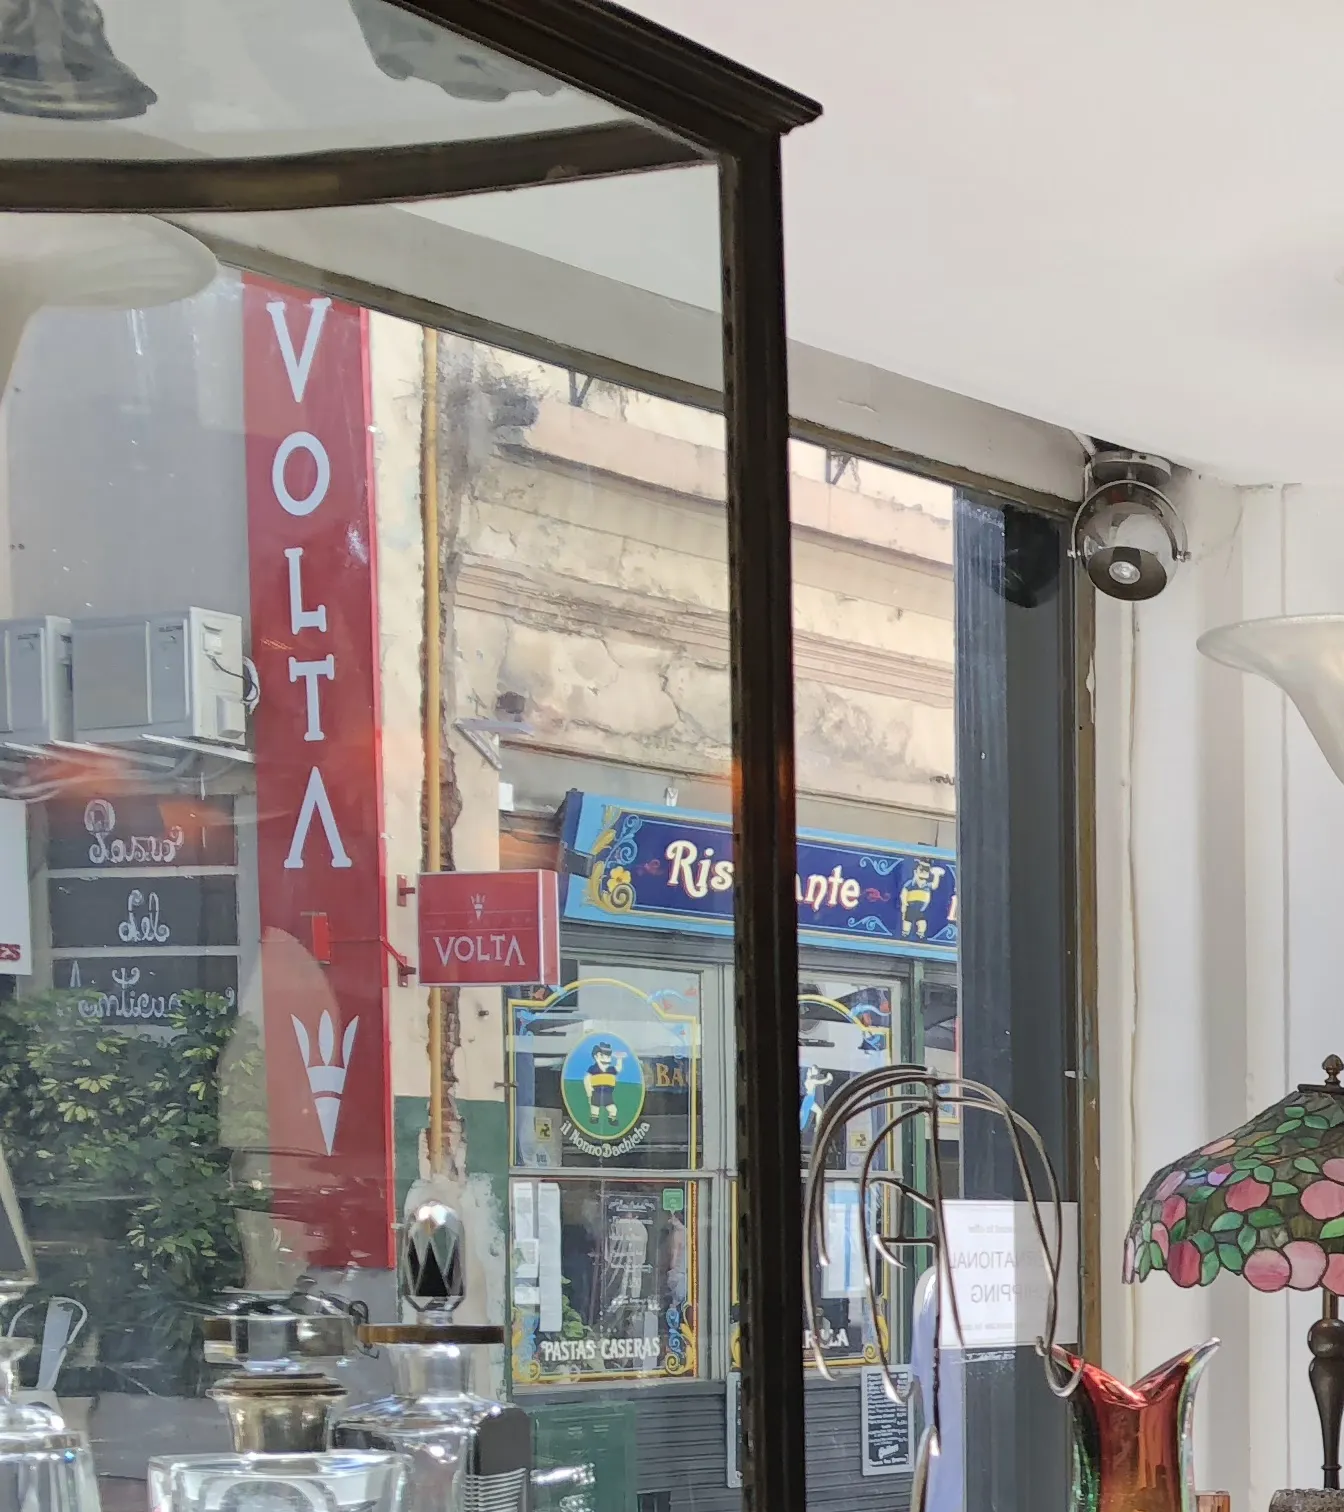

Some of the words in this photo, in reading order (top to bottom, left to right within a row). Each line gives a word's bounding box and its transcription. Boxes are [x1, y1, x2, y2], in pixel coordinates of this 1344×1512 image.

[266, 297, 352, 869] VOLTA
[665, 839, 861, 912] Risnte
[433, 934, 526, 968] VOLTA
[540, 1339, 598, 1361] PASTAS
[600, 1336, 661, 1360] CASERAS
